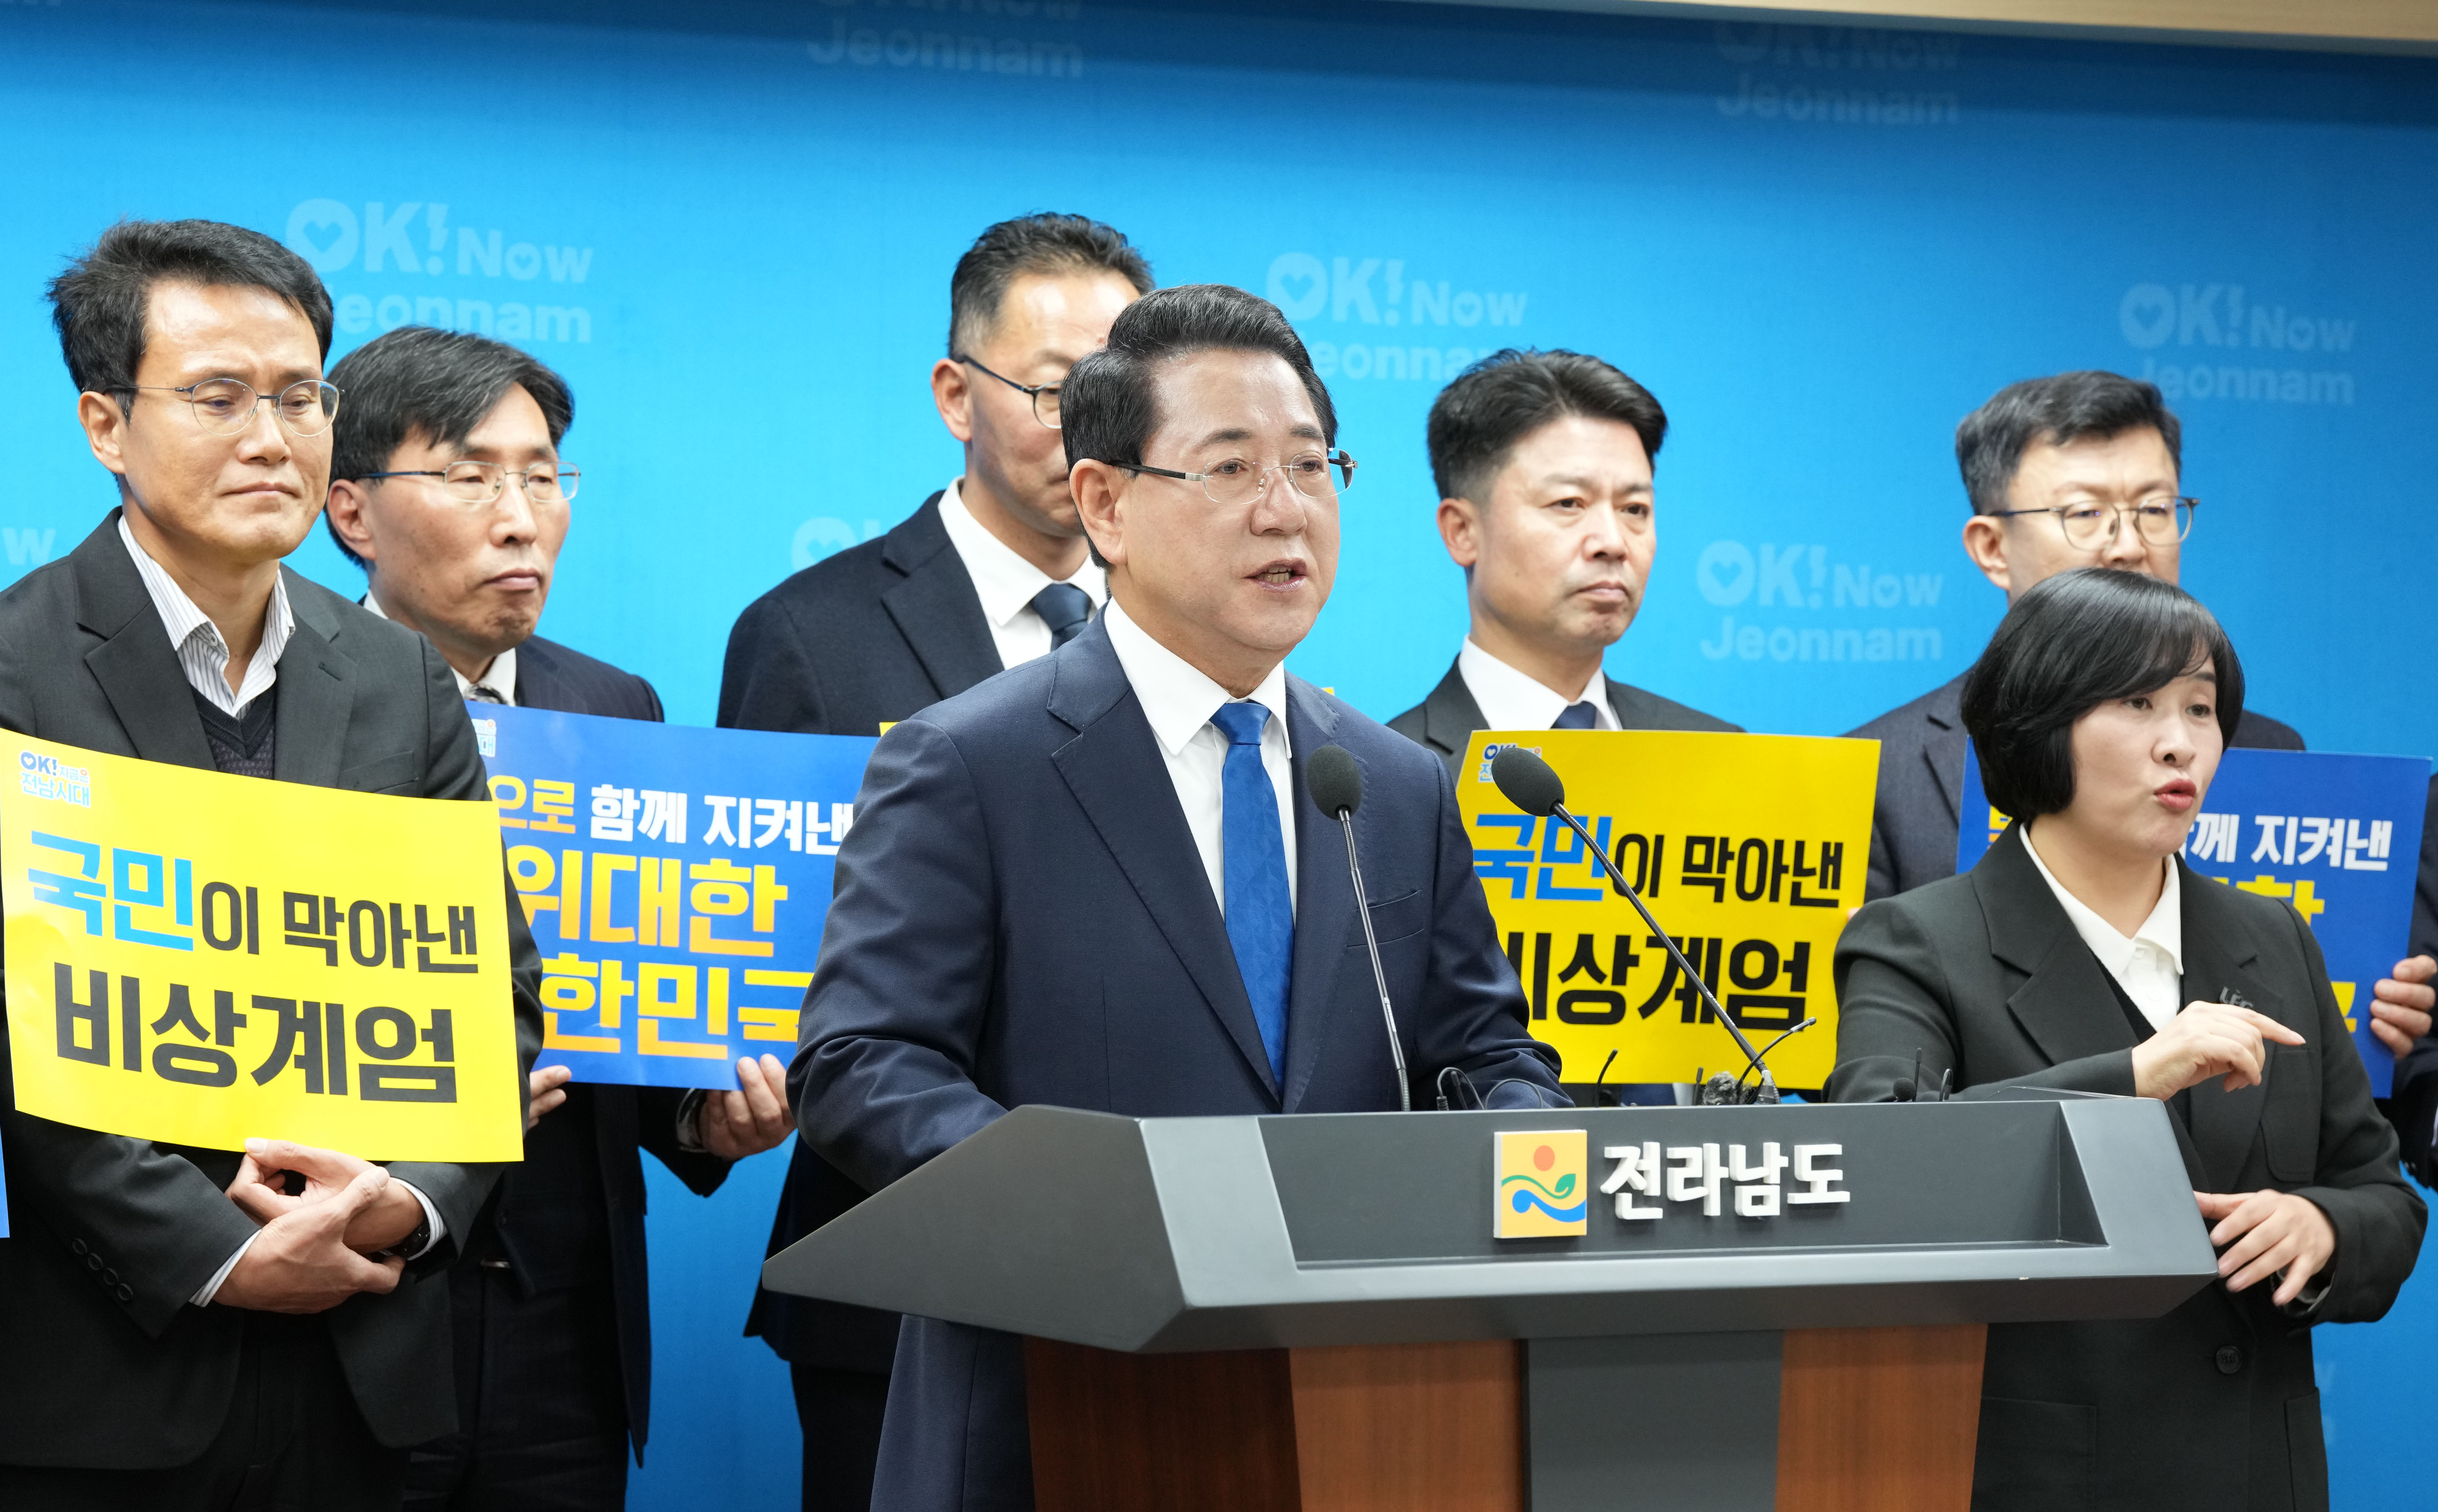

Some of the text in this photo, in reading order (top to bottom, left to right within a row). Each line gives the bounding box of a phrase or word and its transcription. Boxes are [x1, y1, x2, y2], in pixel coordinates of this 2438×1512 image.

[806, 17, 1083, 78] Jeonnam
[1716, 72, 1959, 125] Jeonnam
[286, 198, 593, 283] OK! Now
[327, 283, 591, 343] eonnam
[1266, 252, 1528, 327] OK! Now
[2120, 283, 2358, 353] OK! Now
[1697, 539, 1943, 610] OK! Now
[1700, 615, 1943, 662] Jeonnam
[20, 751, 89, 783] OK! 지금은
[21, 772, 90, 806] 전남시대
[486, 774, 854, 855] 으로 함께 지켜낸
[2177, 813, 2393, 871] 께 지켜낸
[1473, 814, 1844, 908] 국민이 막아낸
[28, 831, 479, 974] 국민이 막아낸
[507, 844, 788, 957] 위대한
[54, 962, 457, 1103] 비상계엄
[539, 952, 814, 1060] 한민국
[1600, 1141, 1850, 1220] 전라남도
